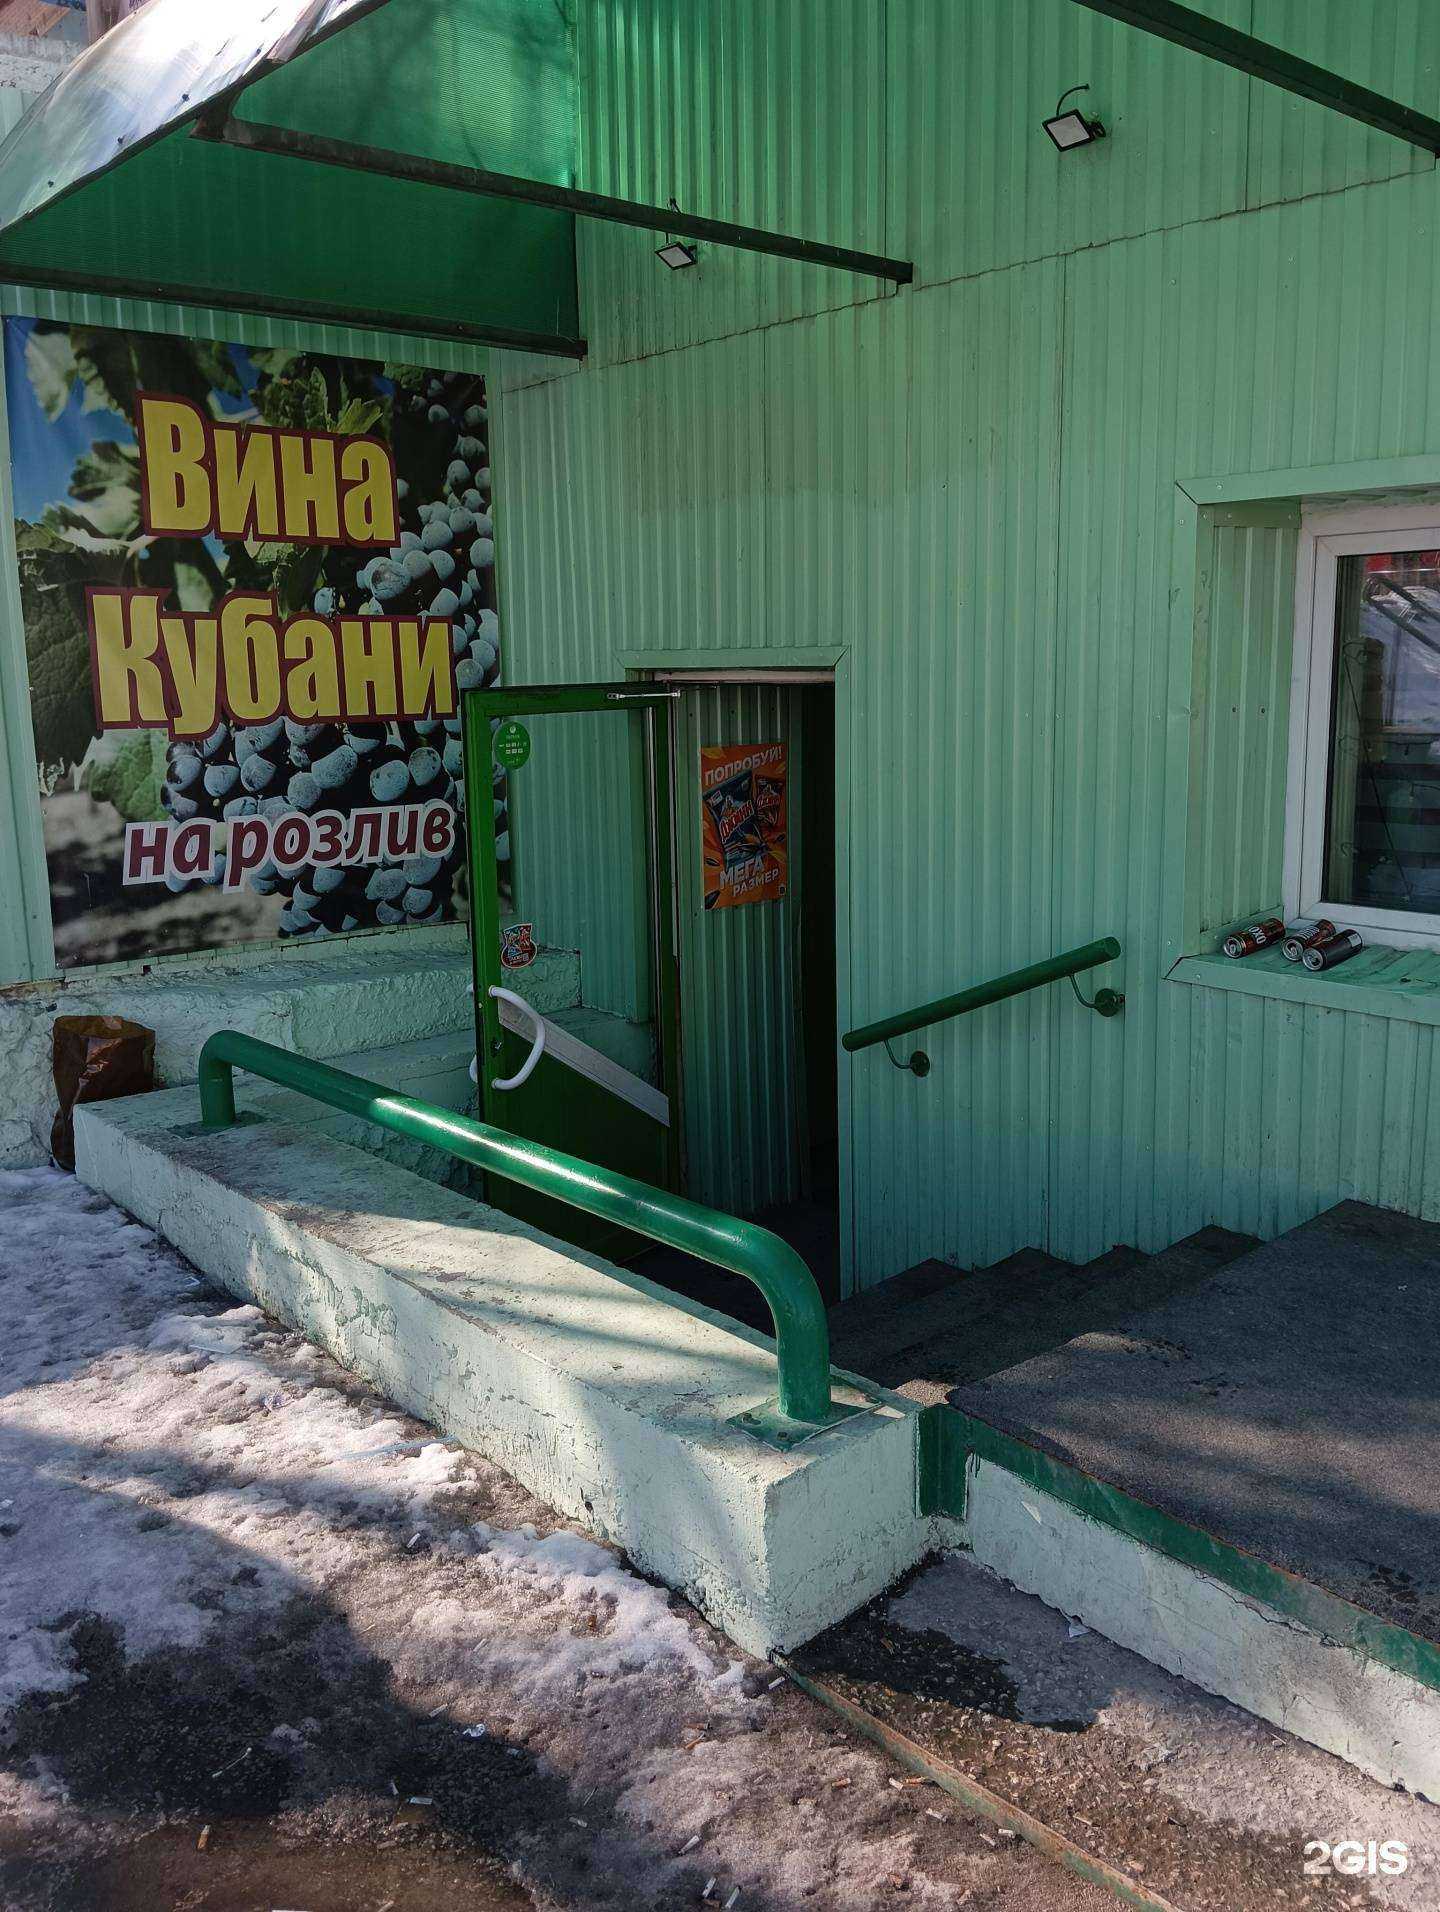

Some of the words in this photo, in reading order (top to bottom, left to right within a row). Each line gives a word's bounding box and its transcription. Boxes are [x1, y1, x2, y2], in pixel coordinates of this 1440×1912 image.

[139, 396, 398, 544] Вина
[90, 591, 455, 737] Кубани
[704, 746, 783, 784] ПОПРОБУЙ!
[126, 818, 213, 883] на
[224, 802, 455, 889] розлив
[719, 855, 765, 889] МЕГА
[733, 868, 780, 897] РАЗМЕР
